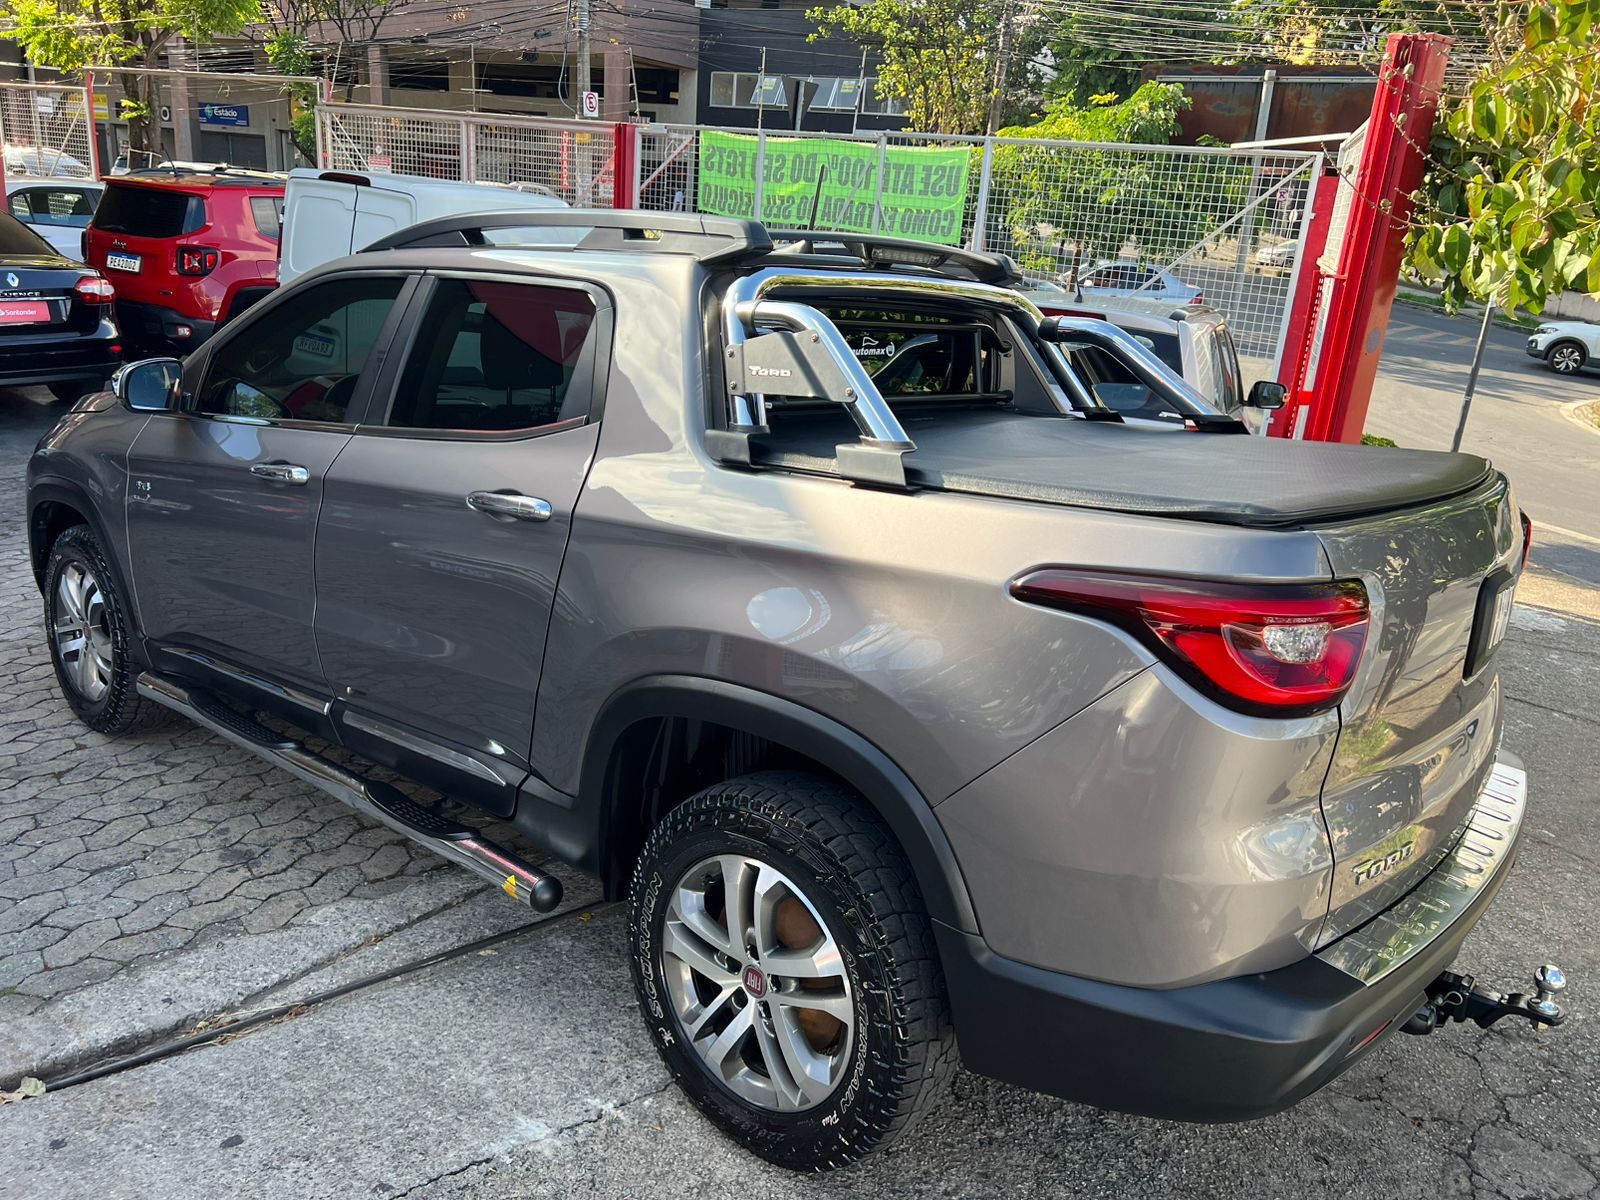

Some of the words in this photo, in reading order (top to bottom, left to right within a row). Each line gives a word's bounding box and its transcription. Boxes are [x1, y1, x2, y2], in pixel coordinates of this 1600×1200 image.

[213, 107, 238, 117] Estácio
[1350, 841, 1416, 886] TORO
[638, 871, 663, 1020] SCORPION
[746, 971, 762, 992] FIAT
[840, 944, 865, 1002] ALL
[840, 1001, 869, 1114] TERRAIN
[821, 1109, 841, 1127] Plus
